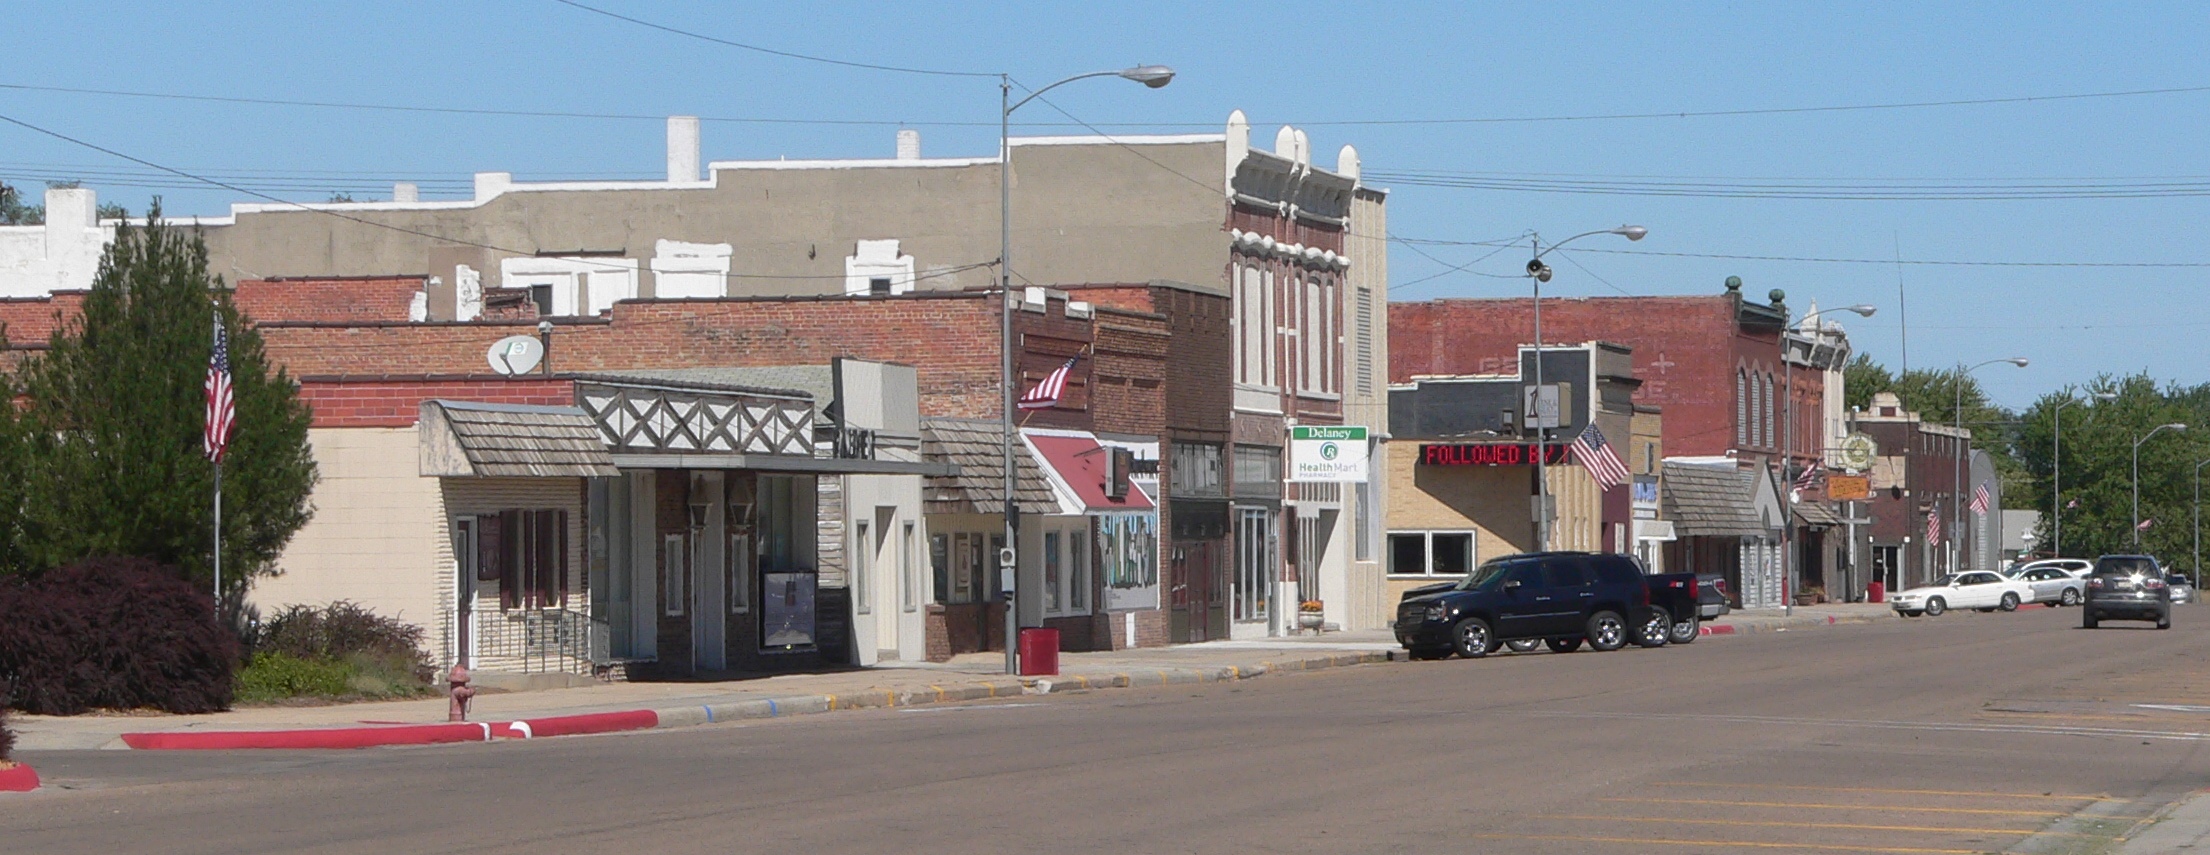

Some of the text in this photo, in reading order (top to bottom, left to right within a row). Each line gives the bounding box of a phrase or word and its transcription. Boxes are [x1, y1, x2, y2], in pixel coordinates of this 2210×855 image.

[1308, 427, 1352, 440] Delaney
[1426, 445, 1520, 465] FOLLOWED
[1528, 445, 1553, 465] BY
[1299, 463, 1357, 472] Health Mart
